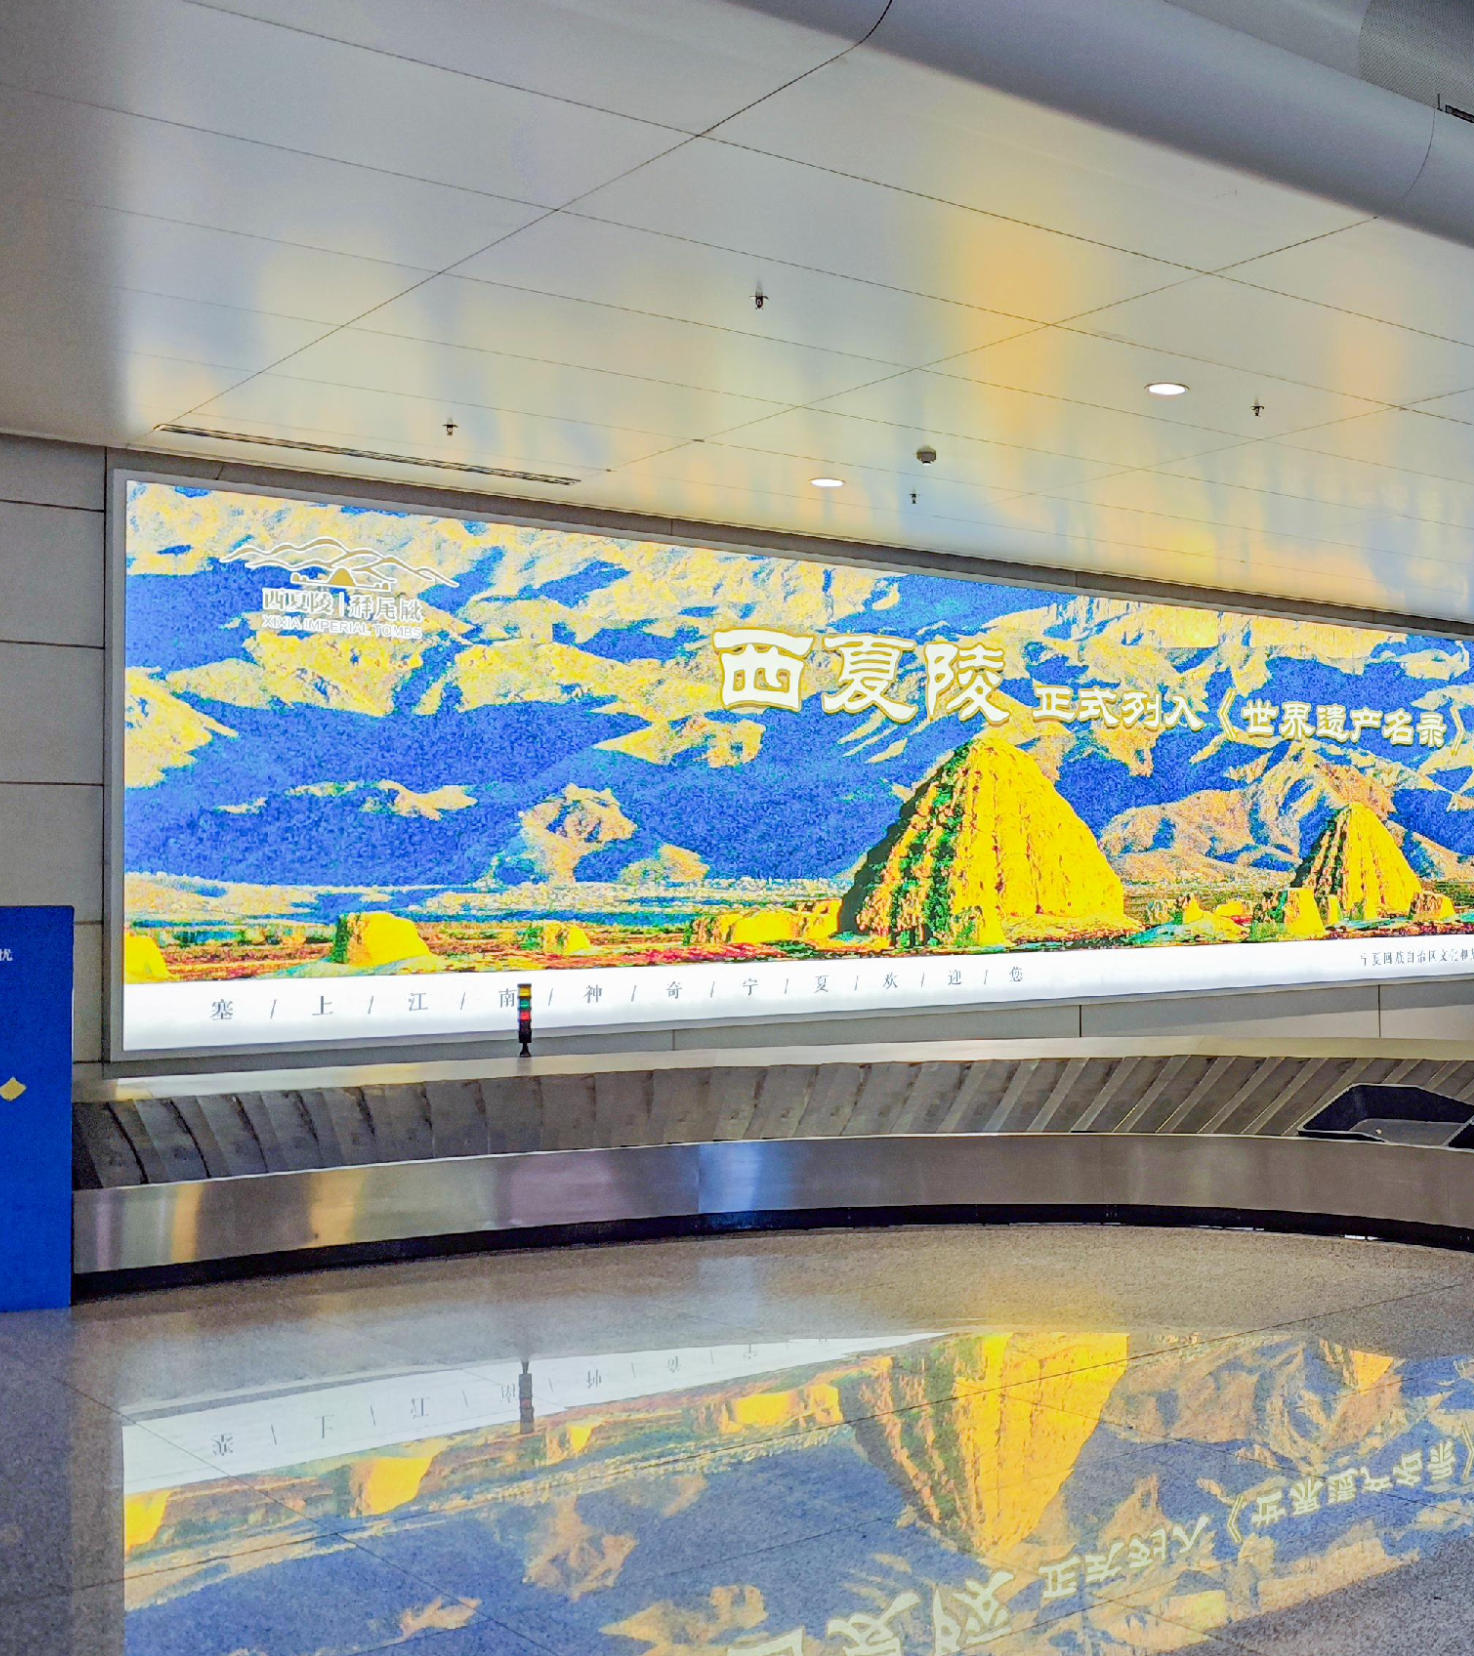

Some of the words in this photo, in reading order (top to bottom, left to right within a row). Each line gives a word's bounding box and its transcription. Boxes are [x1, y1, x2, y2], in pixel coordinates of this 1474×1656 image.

[262, 615, 302, 631] XIXIA
[304, 618, 370, 636] IMPERIAL
[374, 623, 423, 639] TOMBS
[713, 627, 1011, 725] 西夏陵
